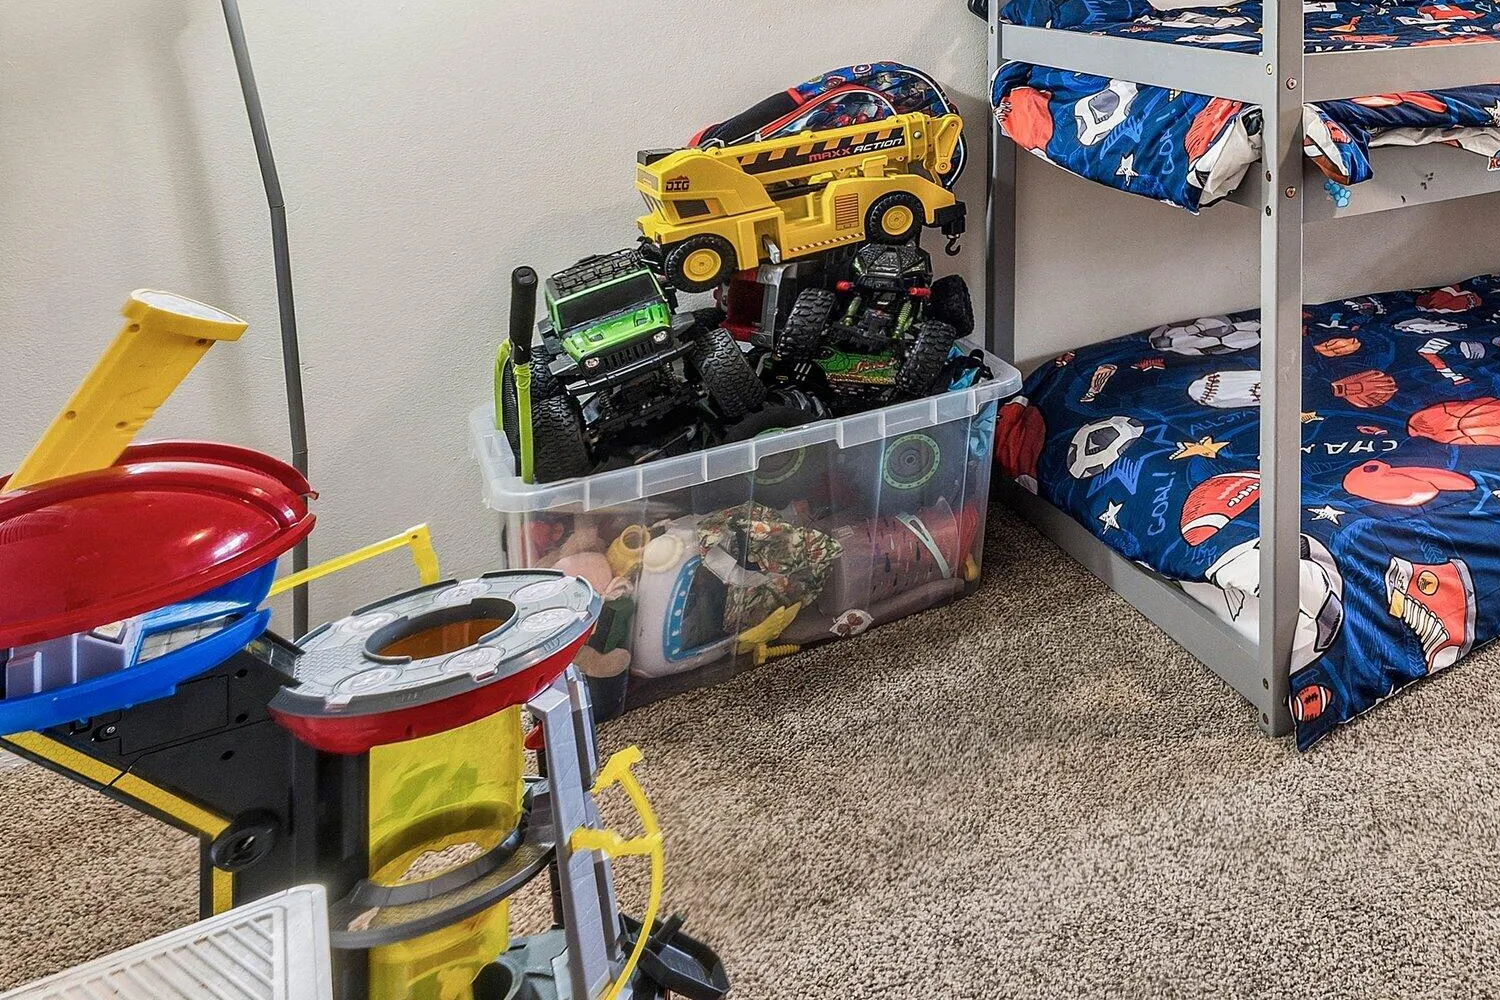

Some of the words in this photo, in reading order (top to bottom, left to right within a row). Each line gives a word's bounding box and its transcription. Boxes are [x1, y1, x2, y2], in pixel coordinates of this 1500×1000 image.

[853, 137, 903, 154] ACTION
[665, 180, 690, 191] DIG
[1147, 470, 1176, 536] GOAL!
